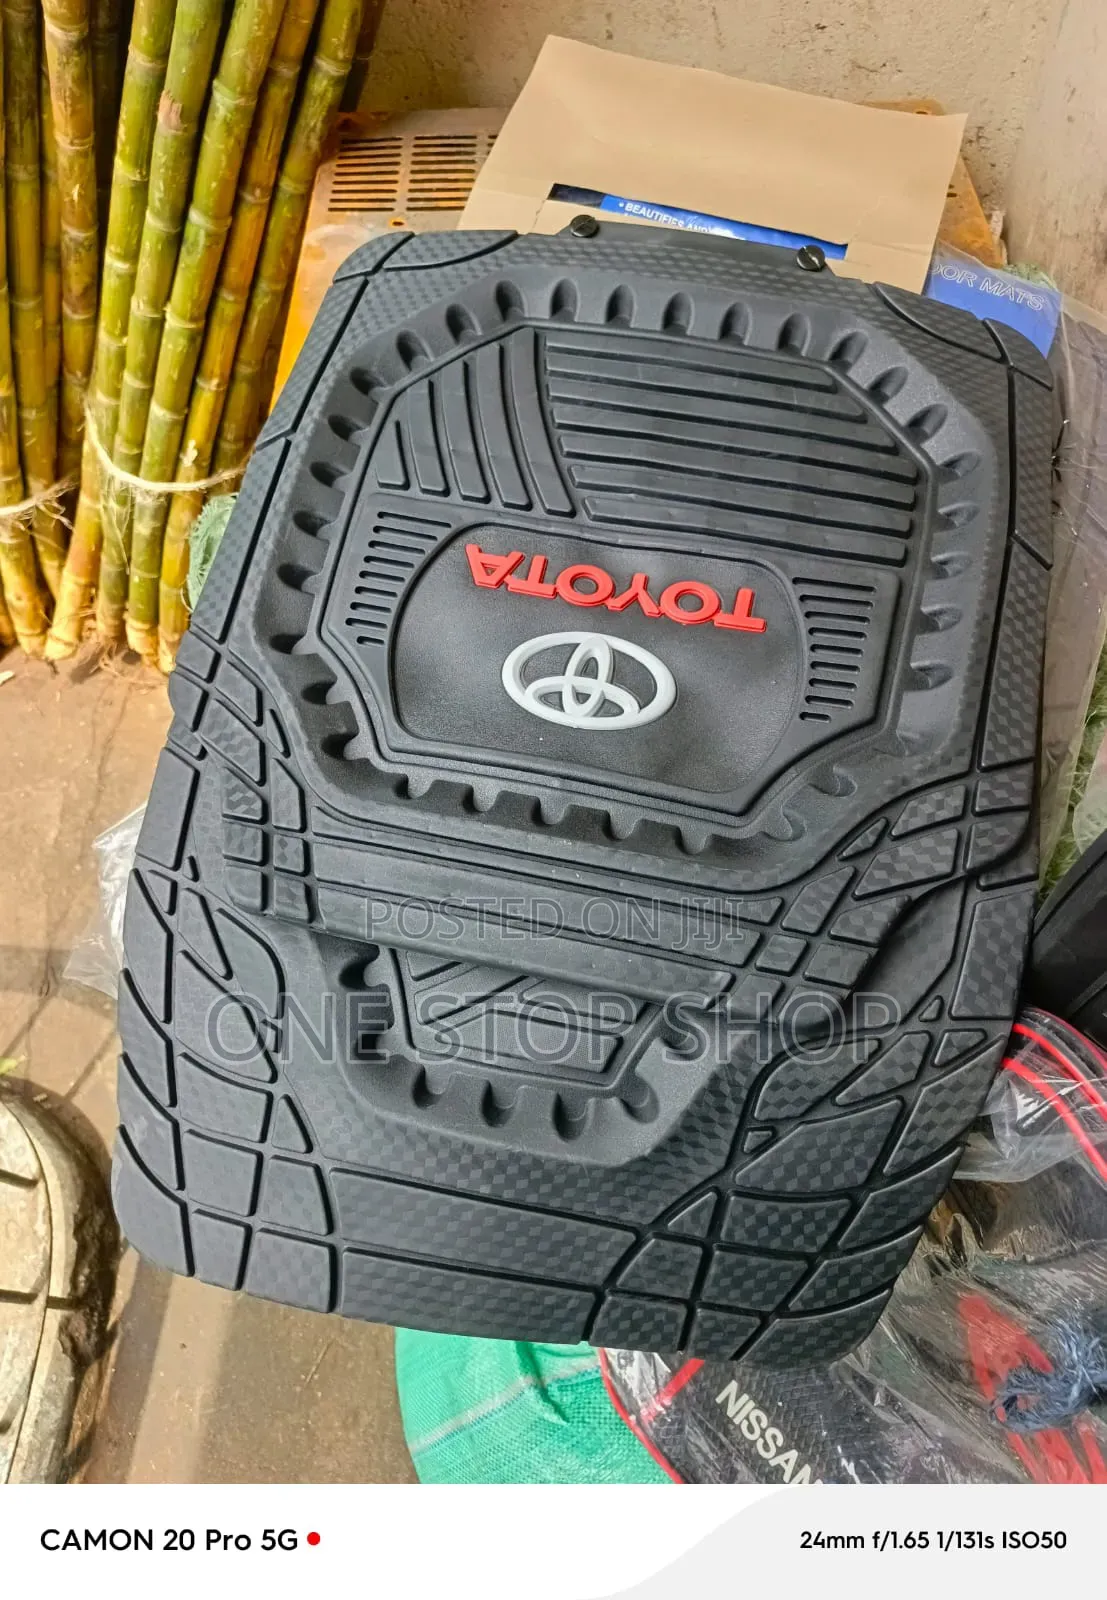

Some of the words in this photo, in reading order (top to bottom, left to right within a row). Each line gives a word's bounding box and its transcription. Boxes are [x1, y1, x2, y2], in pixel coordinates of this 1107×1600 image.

[624, 203, 685, 229] BEAUTIFIES
[979, 276, 1046, 311] MATS
[465, 543, 767, 633] TOYOTA
